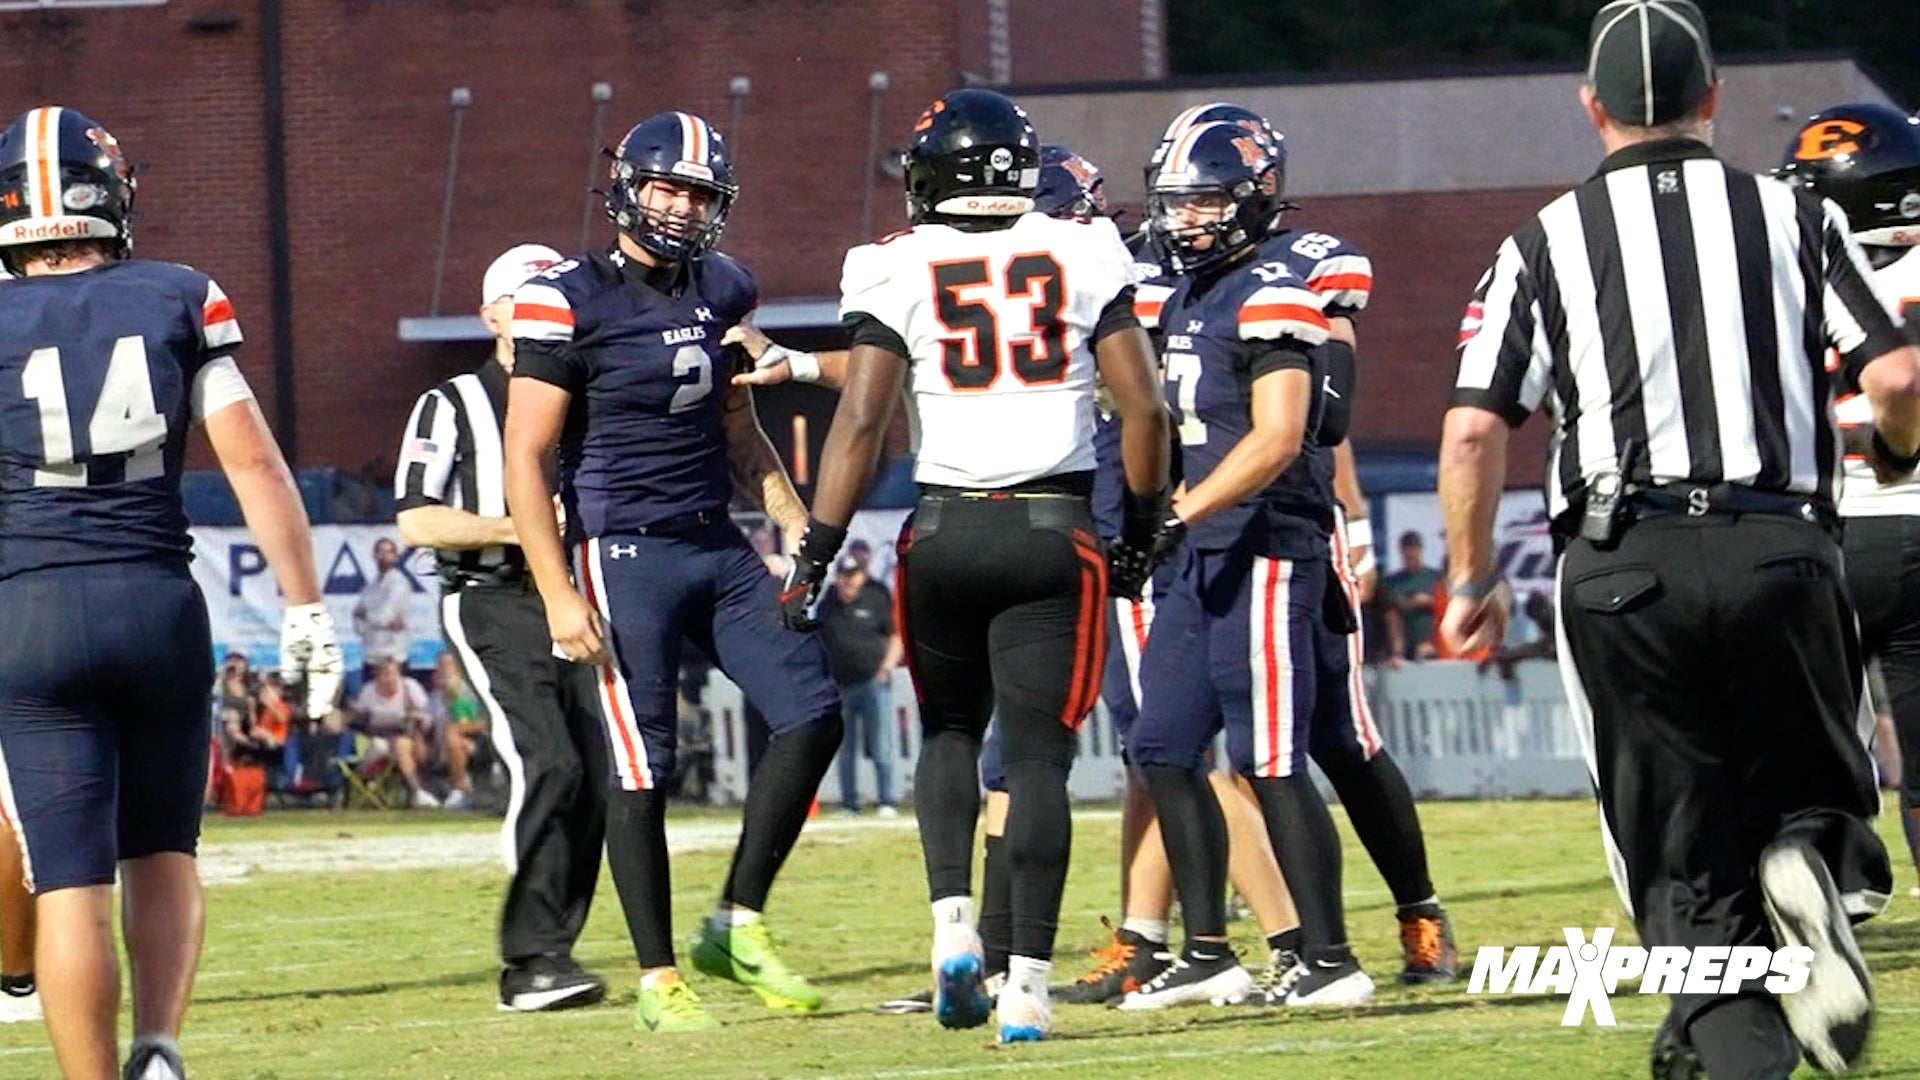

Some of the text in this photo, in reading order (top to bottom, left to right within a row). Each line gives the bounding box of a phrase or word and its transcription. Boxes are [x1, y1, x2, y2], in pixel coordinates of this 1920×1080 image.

[1795, 119, 1866, 160] E
[14, 221, 90, 239] Riddell
[662, 325, 707, 346] EAGLES
[928, 250, 1071, 392] 53
[669, 344, 713, 414] 2
[22, 335, 167, 486] 14
